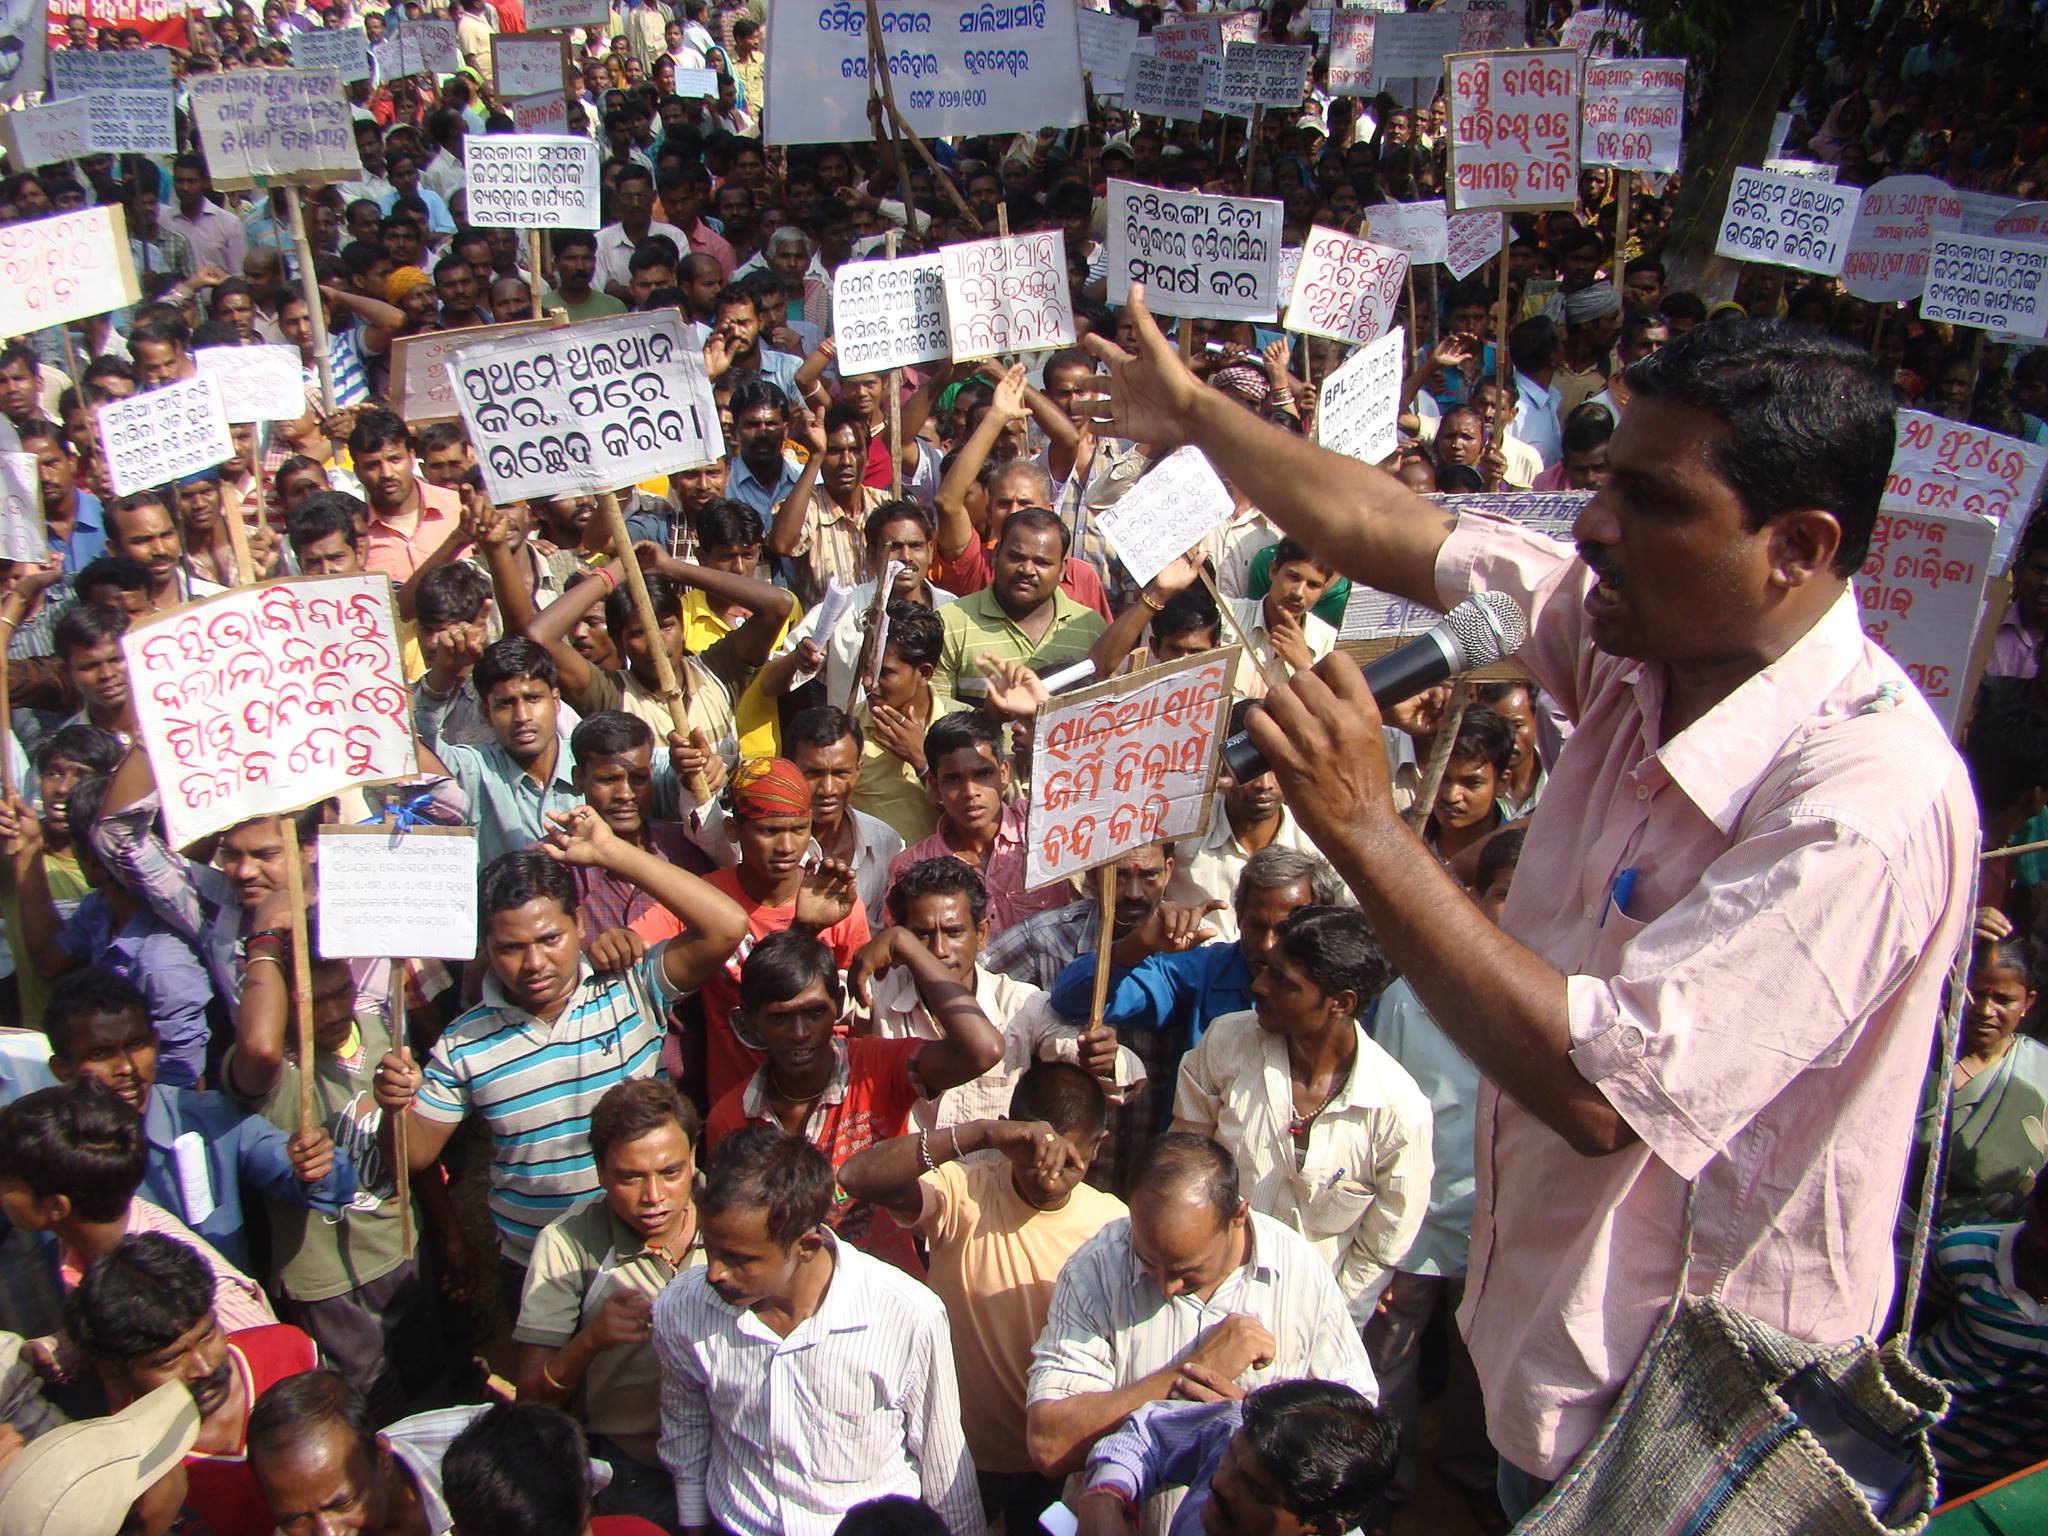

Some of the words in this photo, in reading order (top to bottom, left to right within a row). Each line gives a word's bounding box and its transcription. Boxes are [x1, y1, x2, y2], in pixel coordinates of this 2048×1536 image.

[881, 11, 931, 33] ନଗର
[841, 50, 938, 80] ଜୟବବିହାର
[1457, 61, 1490, 111] ବସ୍ତି
[469, 147, 532, 160] ସରକାରୀ
[1209, 271, 1258, 299] କର
[463, 353, 562, 405] ପ୍ରଥମେ
[567, 333, 673, 381] ଥଇଥାନ
[569, 372, 669, 417] ପରେ
[1324, 382, 1347, 408] BPL
[489, 431, 591, 479] ଉଚ୍ଛେଦ
